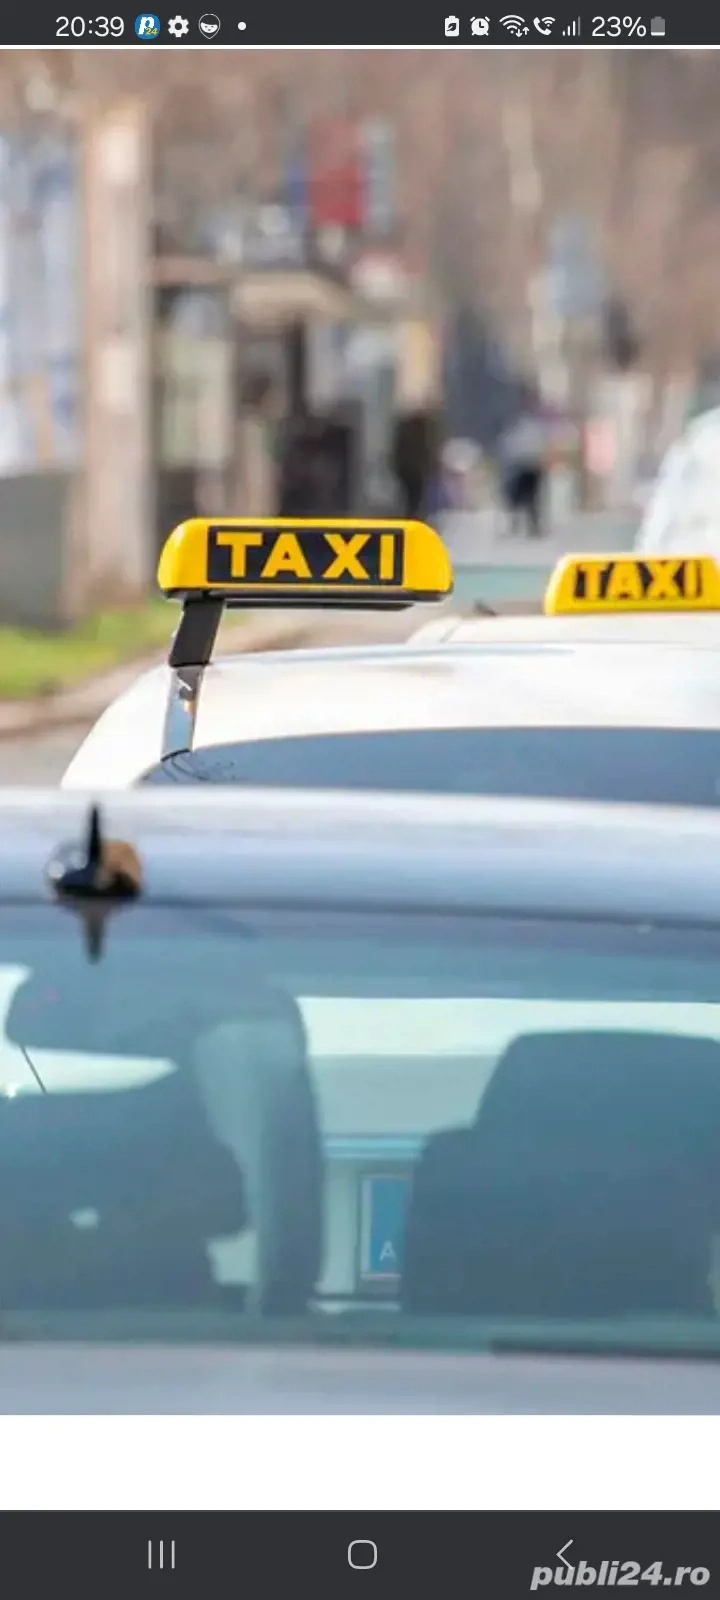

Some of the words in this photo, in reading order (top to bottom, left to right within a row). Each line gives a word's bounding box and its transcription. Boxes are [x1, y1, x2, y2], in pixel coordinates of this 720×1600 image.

[55, 16, 125, 37] 20:39
[591, 16, 647, 37] 23%
[216, 532, 395, 580] TAXI
[575, 560, 699, 599] TAXI
[379, 1240, 397, 1262] A
